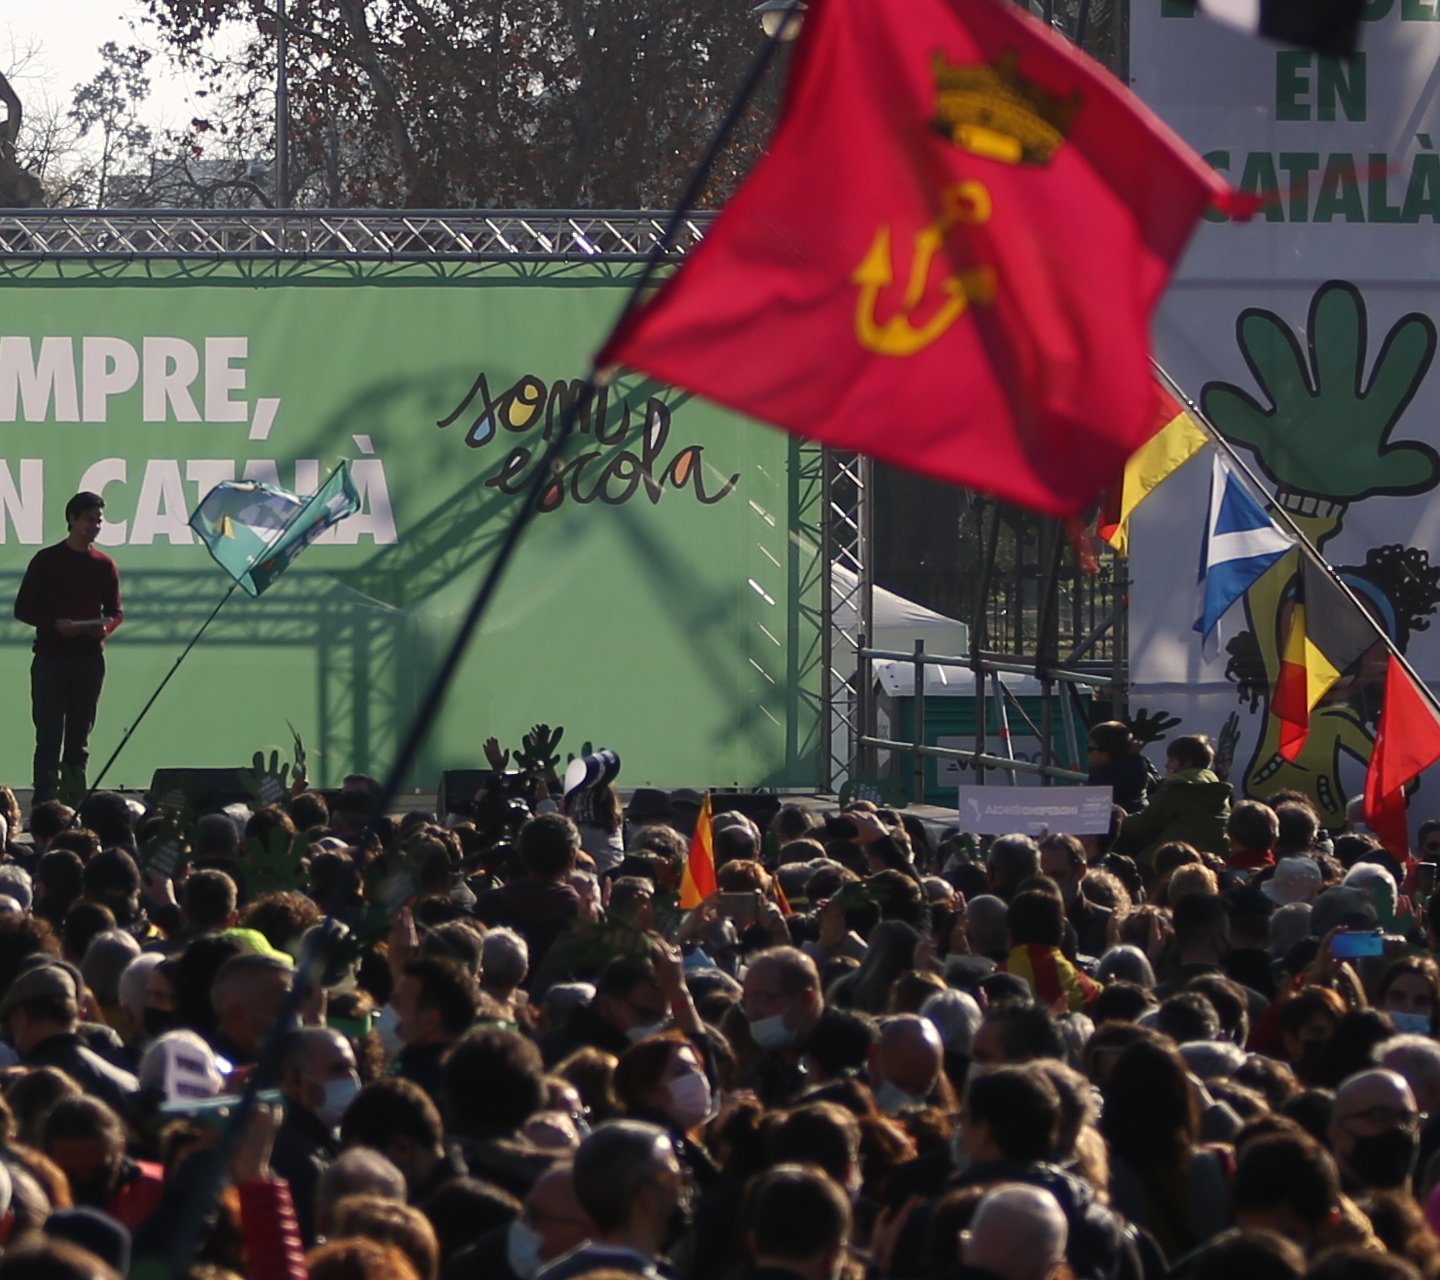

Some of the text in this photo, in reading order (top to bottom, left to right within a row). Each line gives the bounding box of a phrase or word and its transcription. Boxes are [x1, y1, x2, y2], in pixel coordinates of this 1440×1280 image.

[1275, 50, 1367, 123] EN
[436, 372, 631, 446] som
[485, 397, 741, 513] escola
